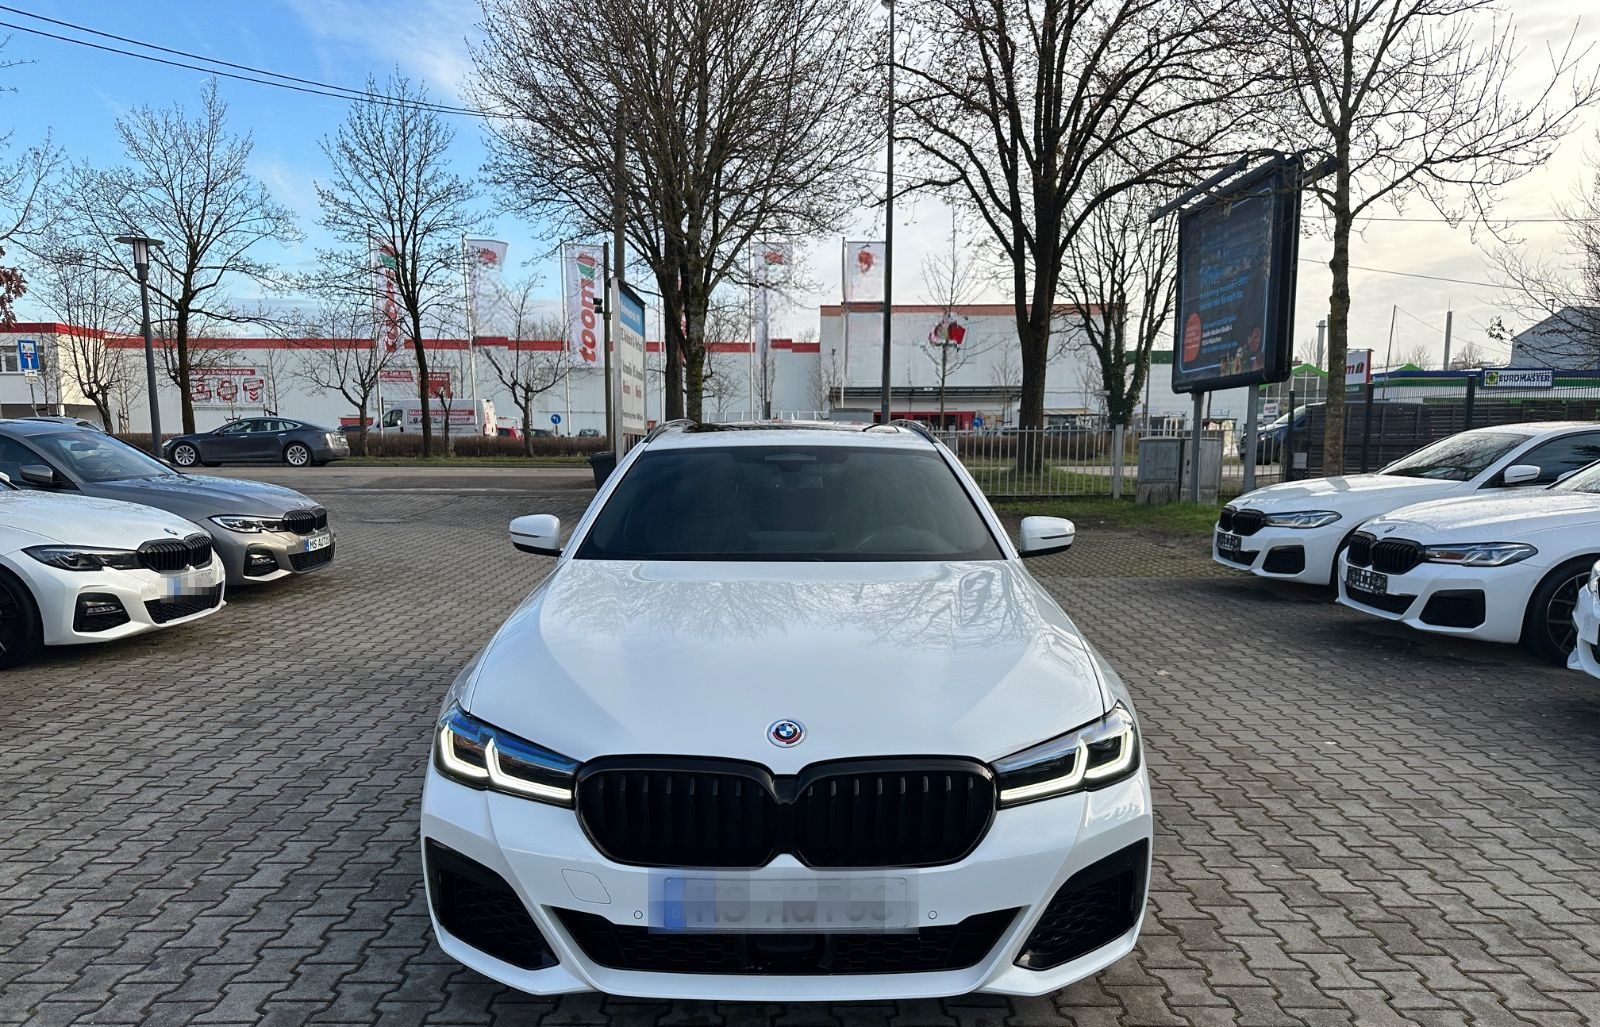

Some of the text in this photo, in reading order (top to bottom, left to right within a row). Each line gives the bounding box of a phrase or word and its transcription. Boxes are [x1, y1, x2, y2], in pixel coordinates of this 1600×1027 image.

[579, 278, 597, 362] toom
[1499, 374, 1551, 382] EUROMASTER
[696, 885, 894, 922] MS AUTOS
